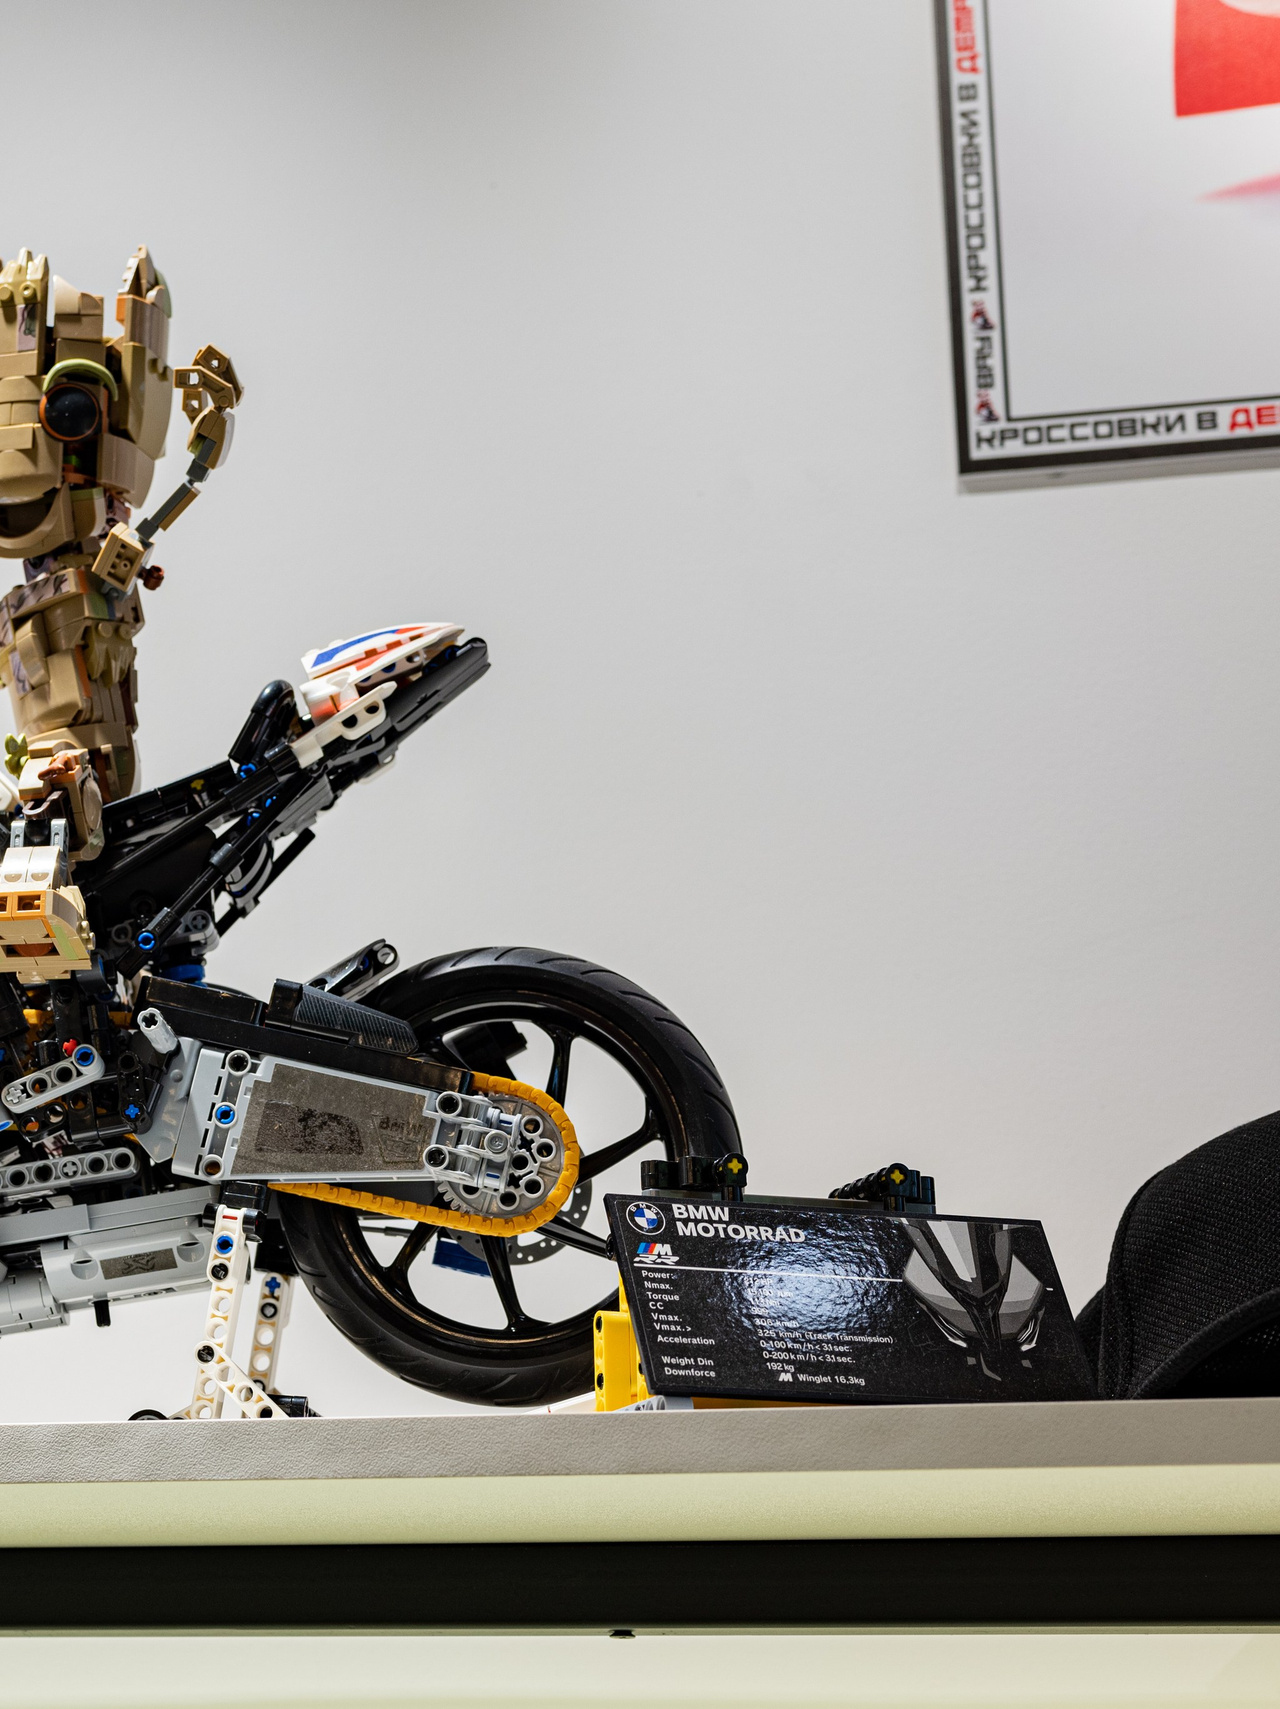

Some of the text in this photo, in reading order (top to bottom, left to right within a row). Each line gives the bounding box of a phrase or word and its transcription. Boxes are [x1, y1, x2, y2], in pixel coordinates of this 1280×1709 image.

[957, 83, 977, 102] В
[960, 109, 988, 292] КРОССОВКИ
[975, 412, 1186, 449] КРОССОВКИ
[1197, 411, 1218, 431] В
[672, 1203, 729, 1221] BMW
[675, 1221, 806, 1243] MOTORRAD
[641, 1270, 673, 1279] Power:
[644, 1281, 673, 1290] Nmax.
[646, 1291, 680, 1302] Torque
[648, 1301, 664, 1310] CC
[651, 1312, 683, 1321] Vmax.
[657, 1335, 716, 1346] Acceleration
[757, 1329, 776, 1337] 325
[779, 1330, 802, 1338] km/h
[834, 1333, 894, 1344] Transmission)
[661, 1356, 714, 1366] Weight Din
[664, 1367, 716, 1377] Downforce
[797, 1373, 832, 1384] Winglet
